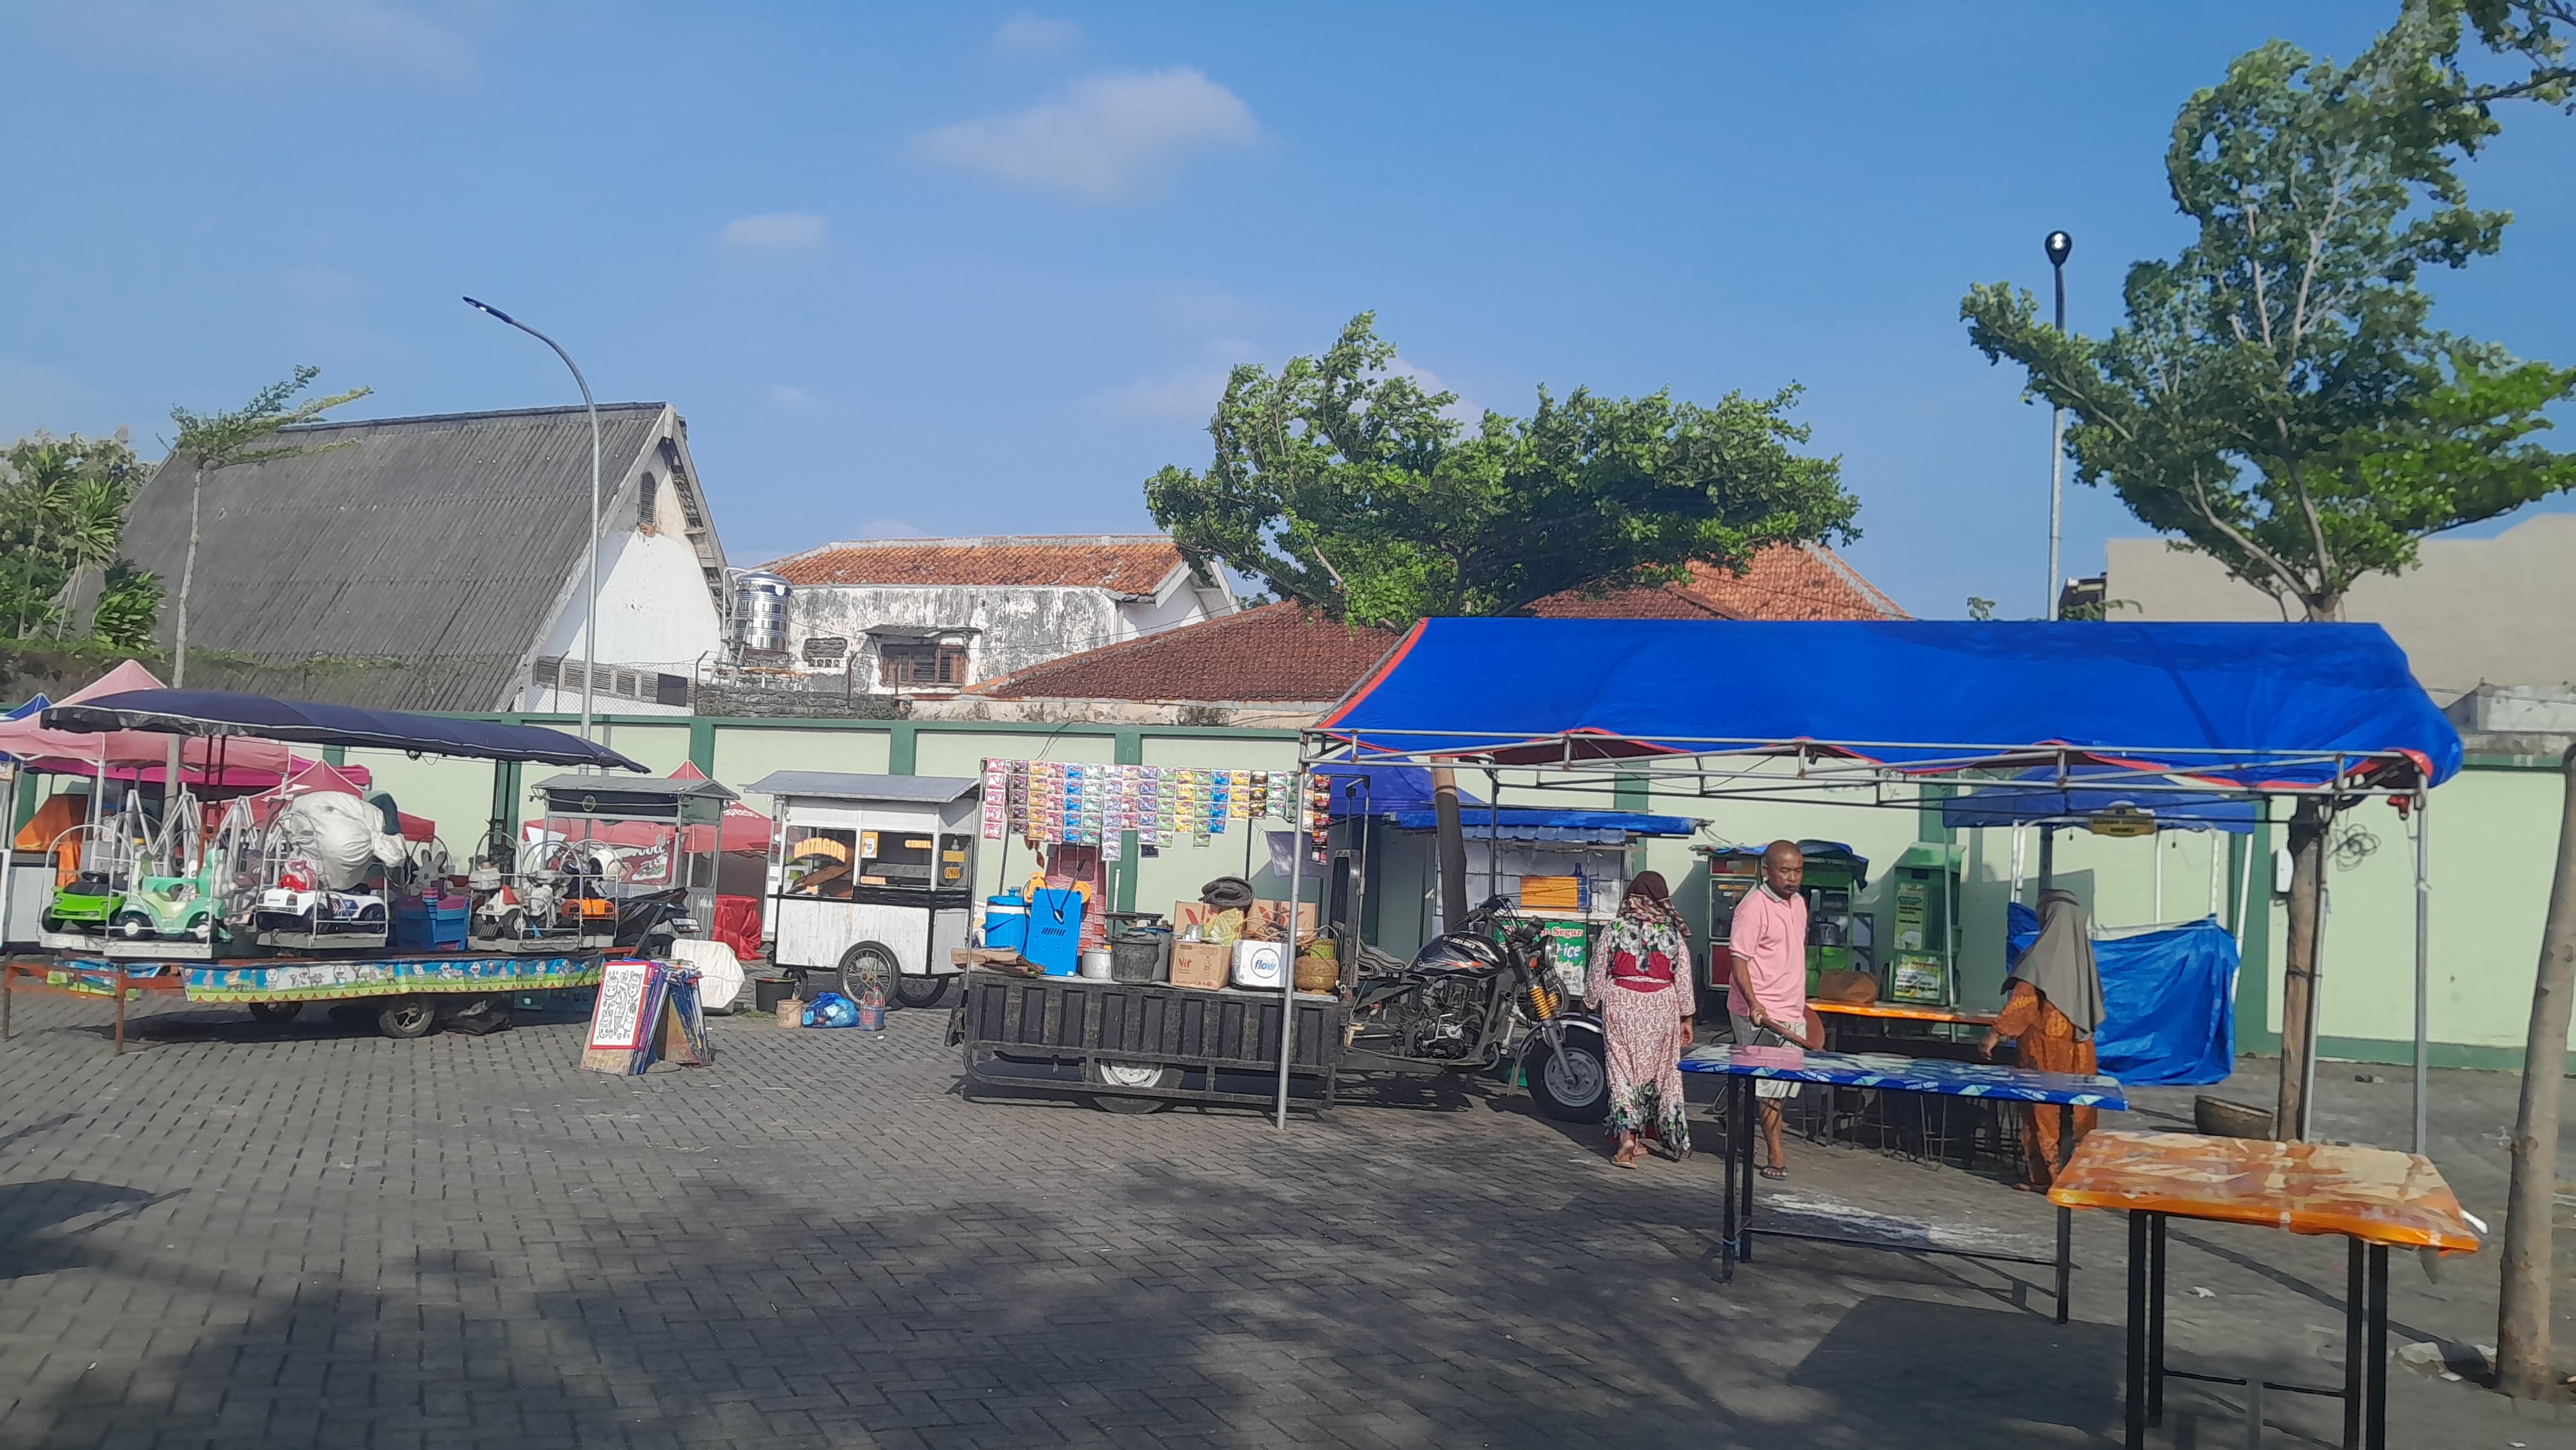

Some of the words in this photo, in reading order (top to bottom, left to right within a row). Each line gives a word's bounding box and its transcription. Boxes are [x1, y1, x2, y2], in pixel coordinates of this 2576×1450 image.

[794, 837, 846, 863] BATAGOR
[1553, 927, 1582, 938] Segar
[1443, 936, 1476, 949] SUZUKI
[1179, 957, 1193, 968] Vit
[1255, 959, 1278, 971] flow
